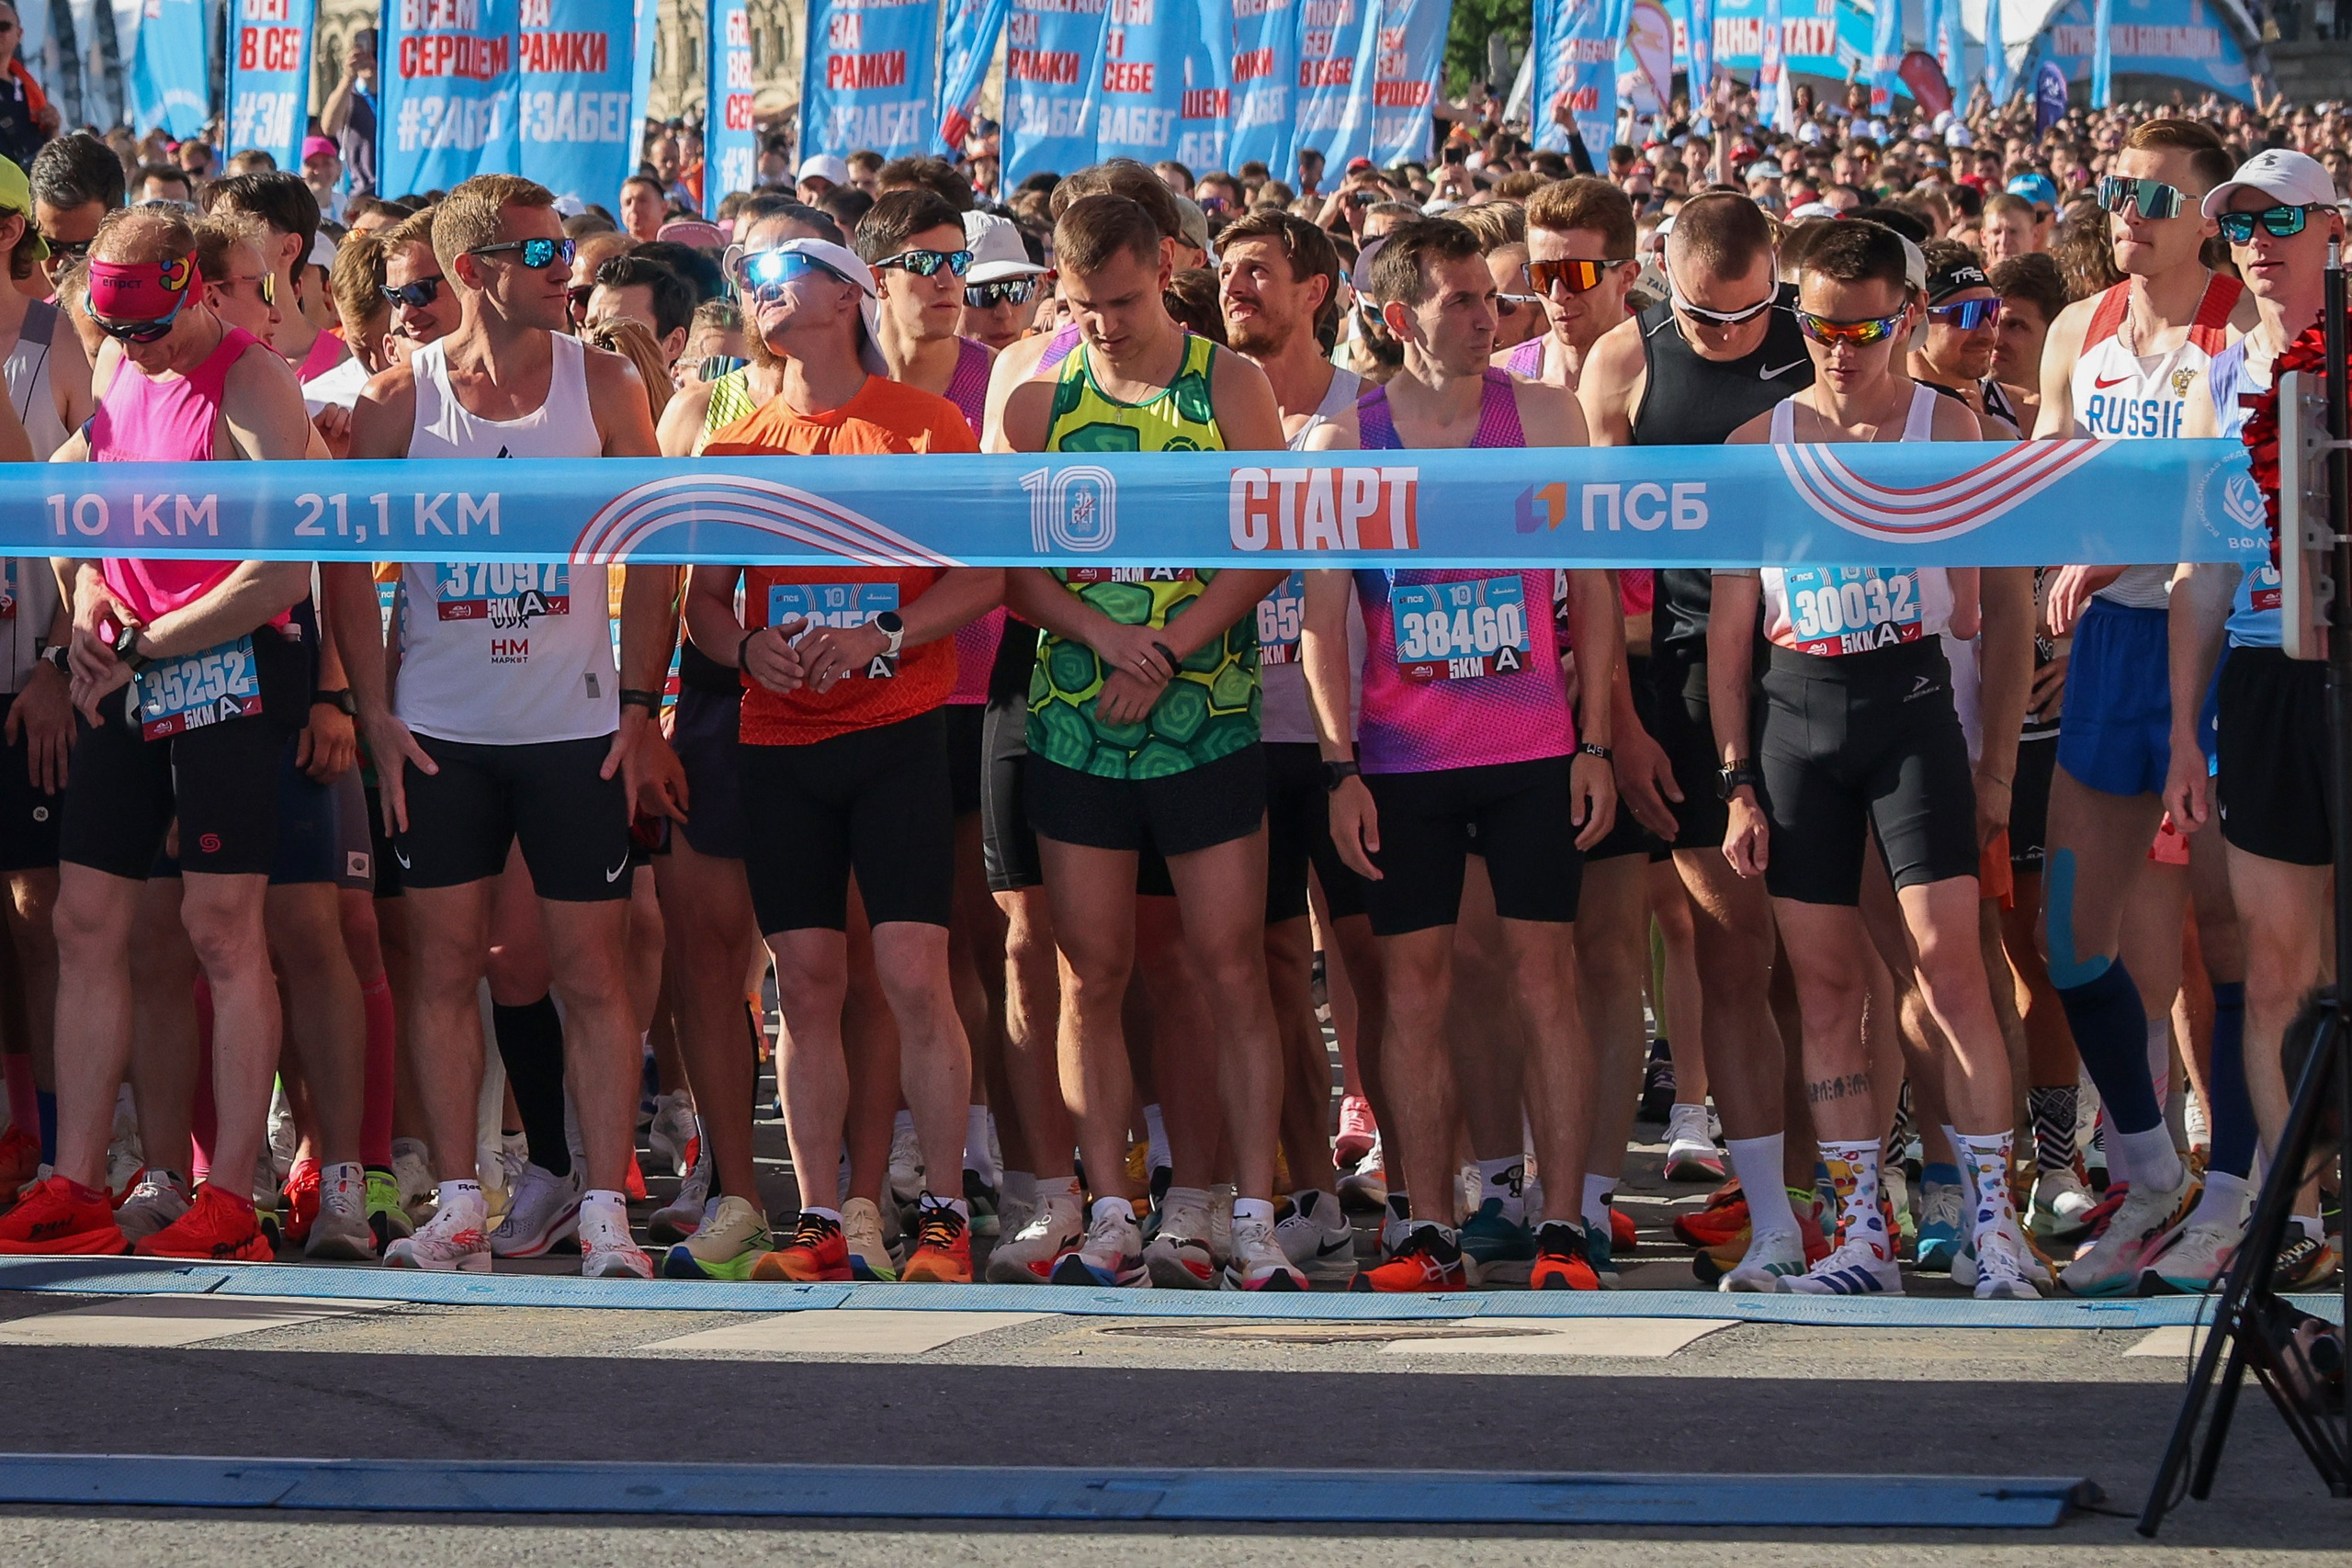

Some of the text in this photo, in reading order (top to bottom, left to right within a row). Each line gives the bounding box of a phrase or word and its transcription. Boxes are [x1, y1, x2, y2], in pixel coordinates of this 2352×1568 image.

[829, 14, 862, 50] ЗА
[520, 33, 607, 73] РАМКИ
[828, 50, 907, 89] РАМКИ
[1008, 48, 1080, 85] РАМКИ
[1102, 62, 1155, 93] СЕБЕ
[1951, 266, 1984, 285] TRS
[47, 493, 108, 536] 10
[293, 492, 390, 544] 21,1
[1019, 466, 1117, 553] 10
[1229, 466, 1419, 550] СТАРТ
[1581, 482, 1709, 531] ПСБ
[825, 587, 845, 608] 10
[1449, 585, 1472, 606] 10
[1794, 574, 1915, 637] 30032
[1402, 603, 1522, 659] 38460
[143, 650, 250, 716] 35252
